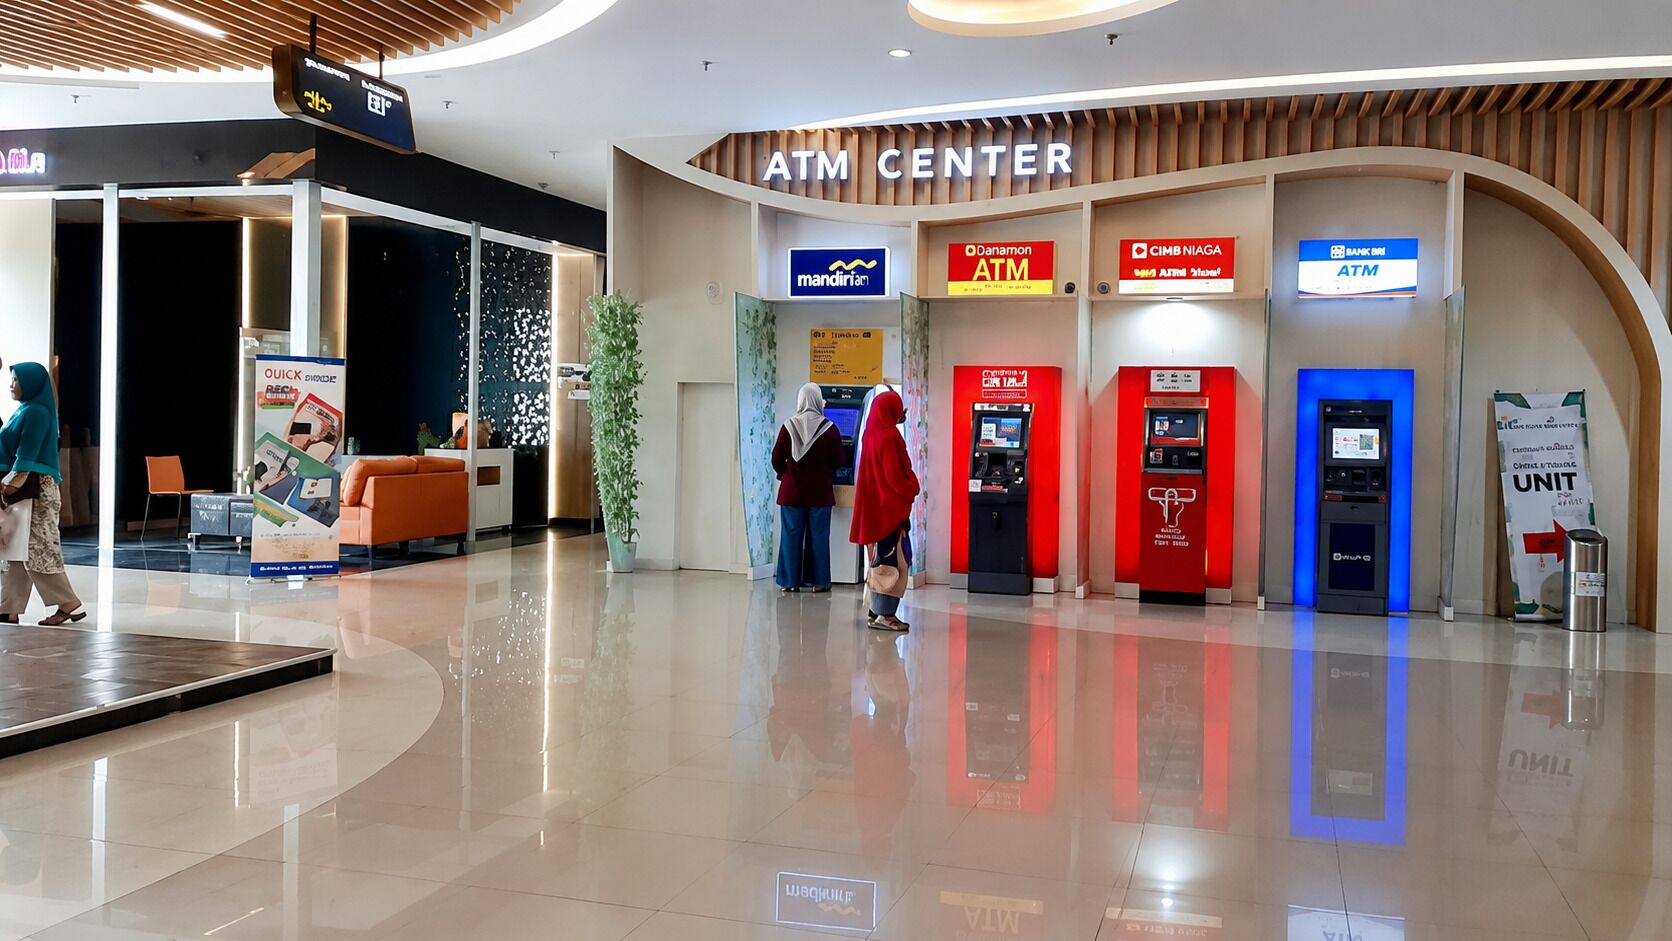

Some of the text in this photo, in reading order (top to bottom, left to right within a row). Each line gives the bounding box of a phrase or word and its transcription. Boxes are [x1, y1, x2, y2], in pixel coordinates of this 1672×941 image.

[762, 142, 1073, 181] ATM CENTER
[977, 245, 1032, 256] Danamon
[1149, 244, 1222, 257] CIMB NIAGA
[1346, 247, 1371, 256] BANK
[972, 258, 1029, 281] ATM
[1337, 264, 1379, 277] ATM
[797, 271, 855, 287] mandiri
[1512, 472, 1577, 493] UNIT
